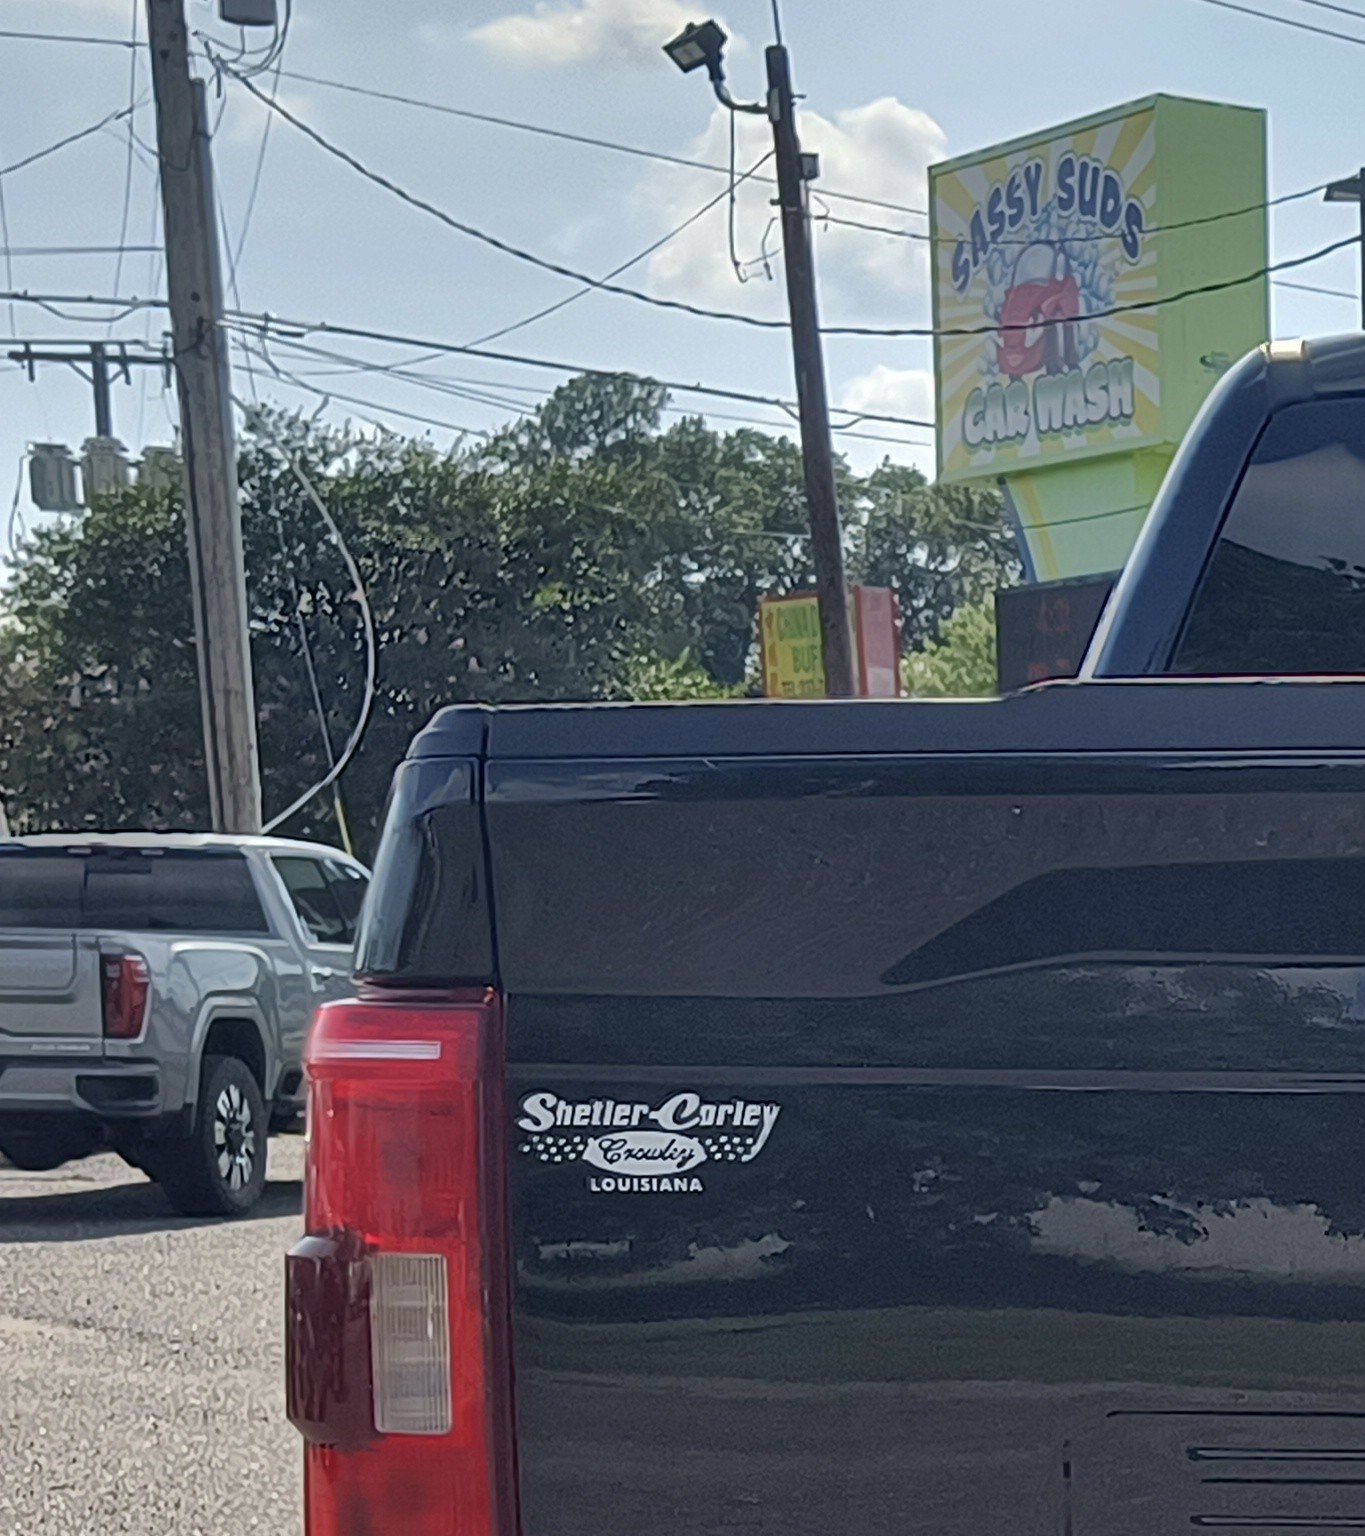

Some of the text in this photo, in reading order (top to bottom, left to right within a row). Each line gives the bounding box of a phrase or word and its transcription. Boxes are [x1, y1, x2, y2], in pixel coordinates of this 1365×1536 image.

[951, 155, 1144, 290] SASSY SUDS
[963, 356, 1134, 447] CAR WASH
[518, 1092, 780, 1163] Shetler-Corley
[599, 1139, 695, 1168] Crowley
[590, 1177, 704, 1193] LOUISIANA
